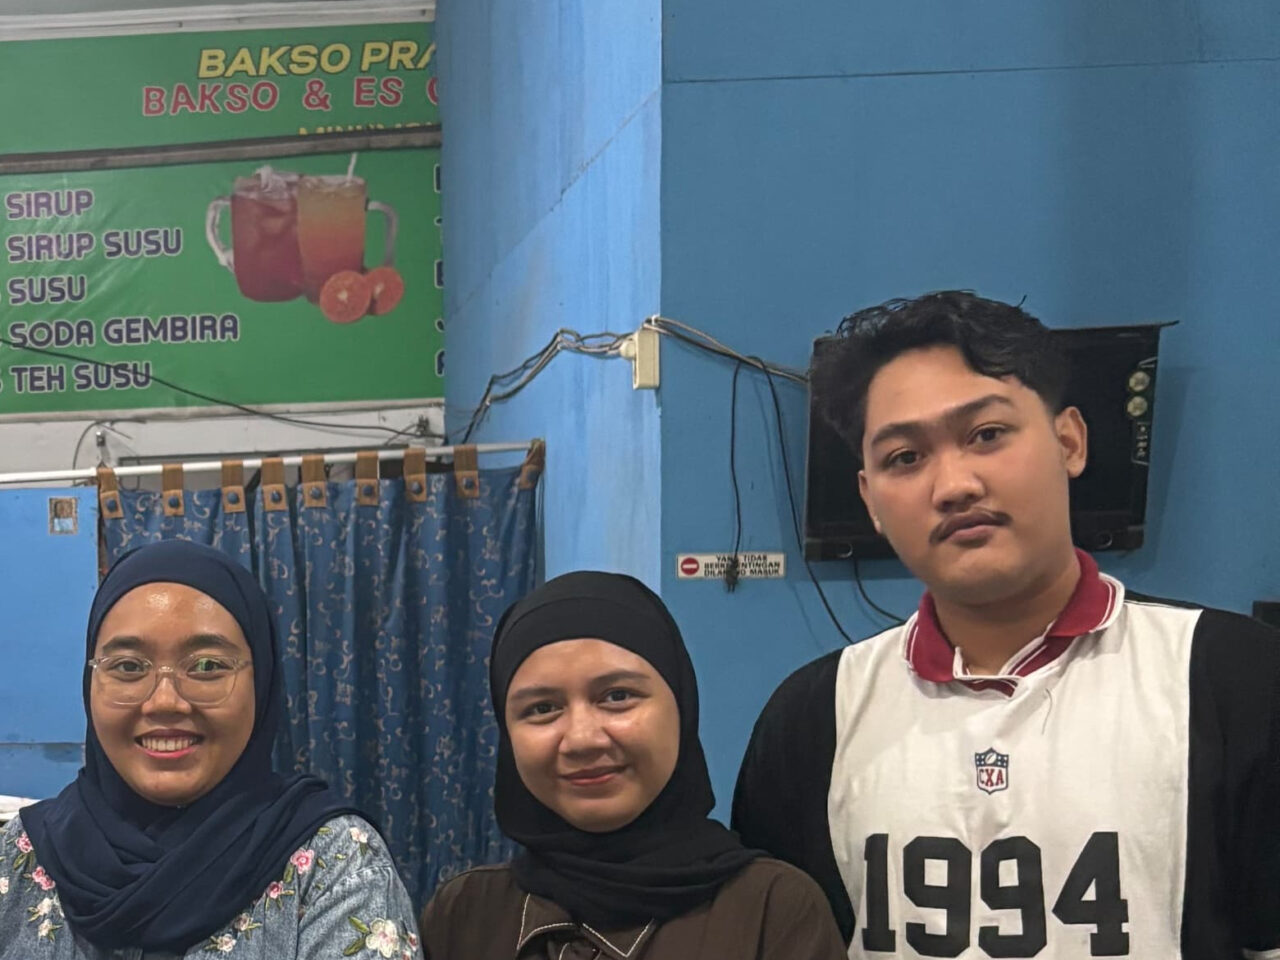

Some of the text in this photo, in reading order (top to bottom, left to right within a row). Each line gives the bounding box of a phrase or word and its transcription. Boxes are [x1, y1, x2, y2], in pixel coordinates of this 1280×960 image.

[198, 43, 352, 79] BAKSO
[143, 81, 279, 116] BAKSO
[303, 79, 332, 111] &
[354, 76, 404, 108] ES
[6, 190, 94, 218] SIRUP
[8, 233, 94, 263] SIRUP
[104, 229, 182, 258] SUSU
[8, 275, 86, 304] SUSU
[11, 319, 94, 348] SODA
[103, 313, 240, 345] GEMBIRA
[12, 364, 65, 392] TEH
[76, 361, 151, 389] SUSU
[979, 768, 1004, 787] CXA
[862, 831, 1130, 958] 1994
